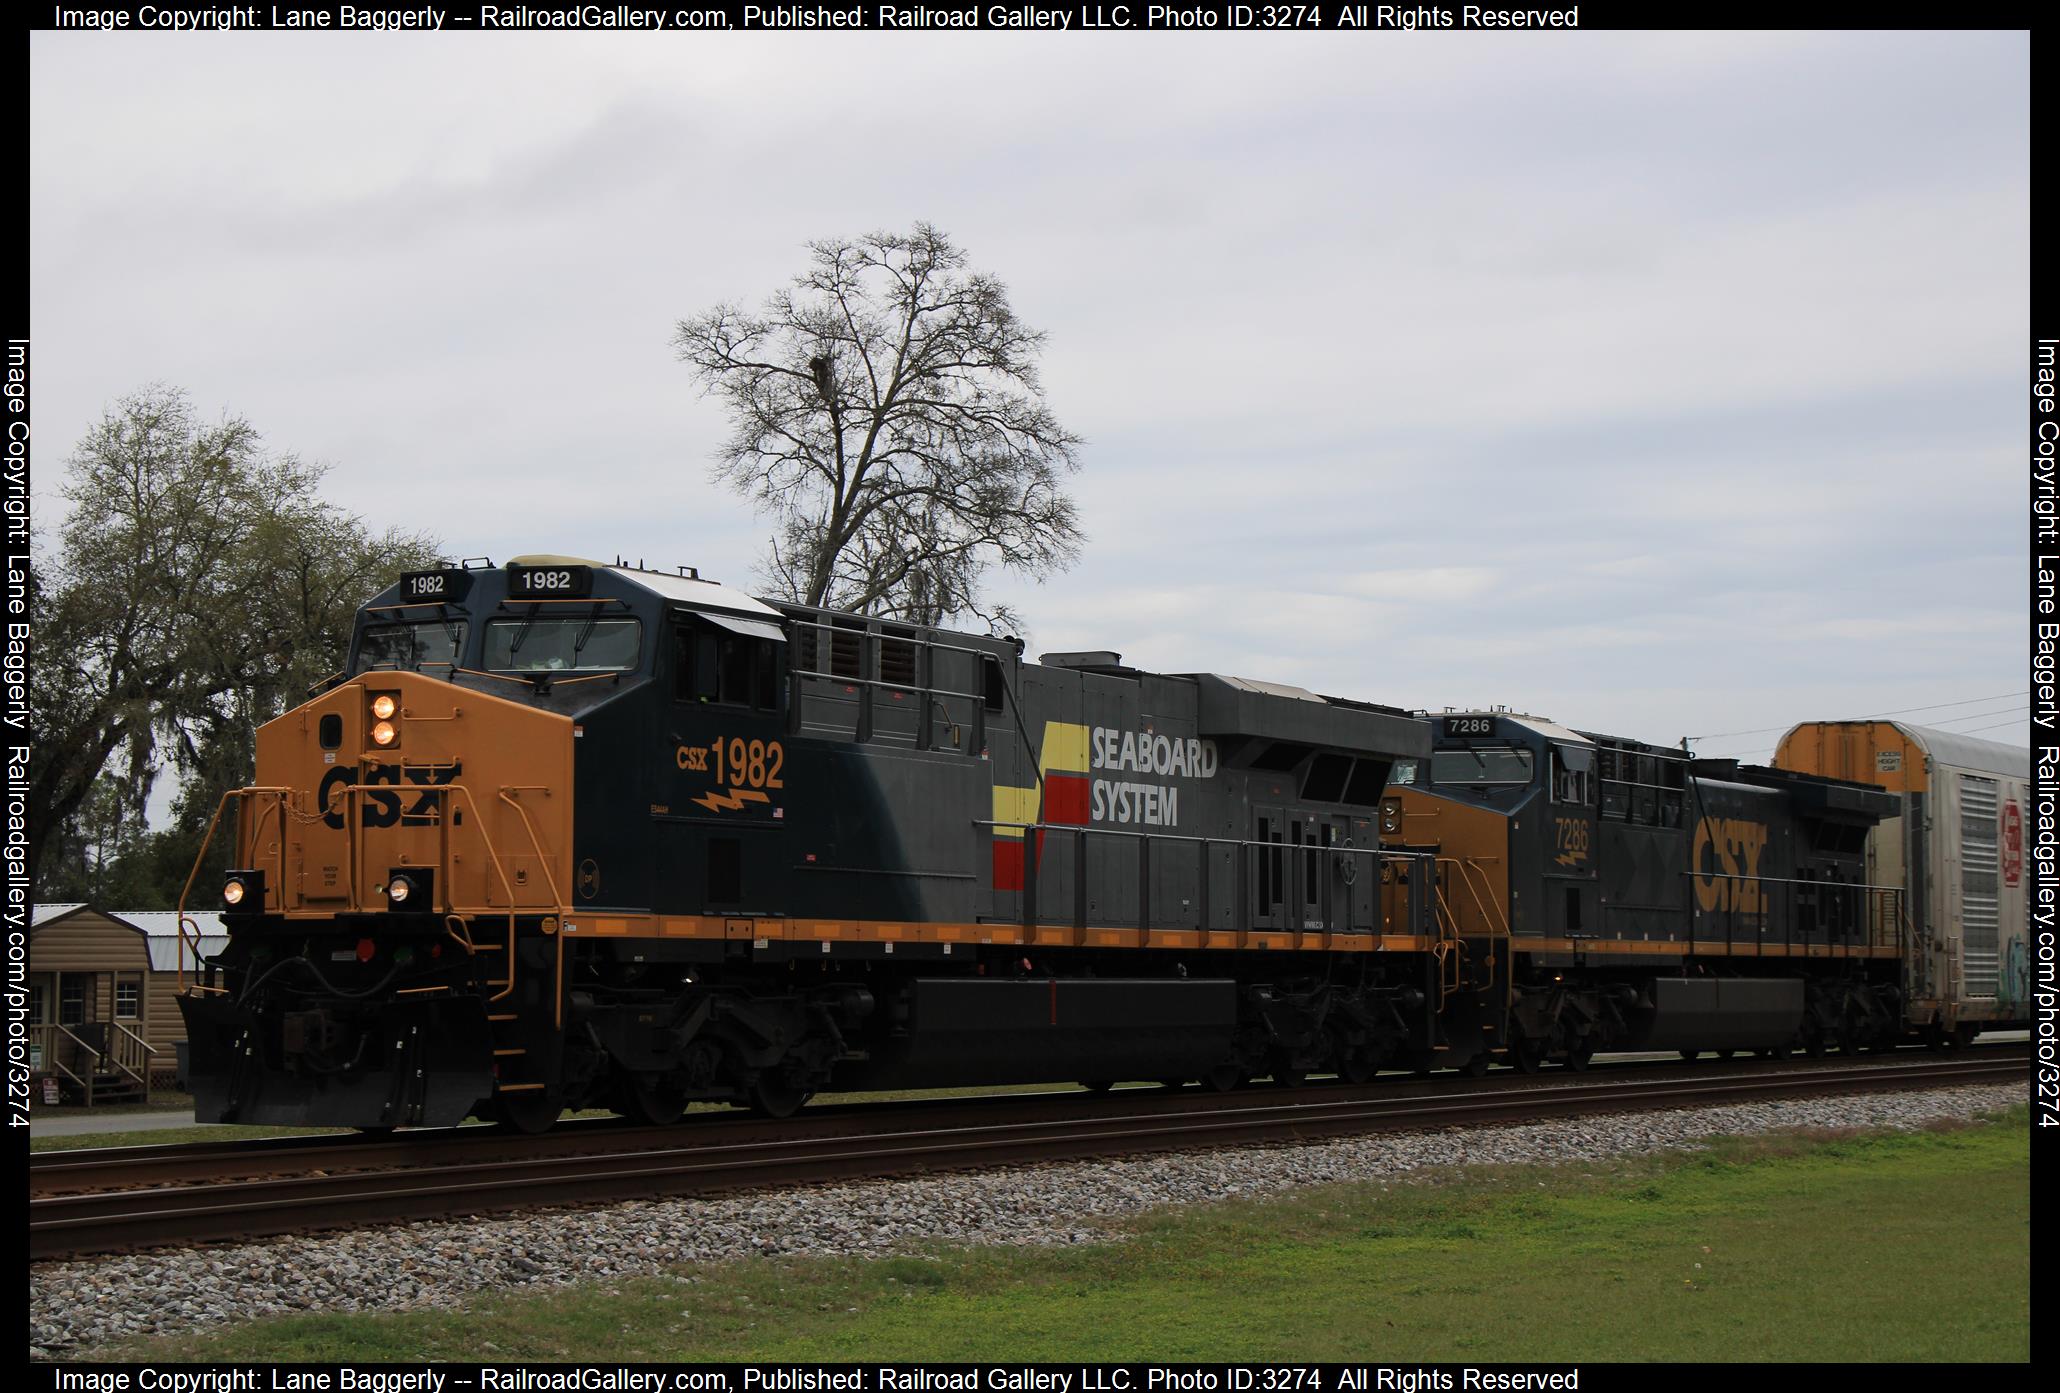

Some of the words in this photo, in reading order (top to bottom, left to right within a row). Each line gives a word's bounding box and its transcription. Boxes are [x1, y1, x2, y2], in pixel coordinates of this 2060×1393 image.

[411, 575, 444, 594] 1982
[522, 571, 571, 589] 1982
[1450, 719, 1490, 732] 7286
[676, 745, 708, 771] CSX
[711, 735, 784, 789] 1982
[1092, 726, 1218, 778] SEABOARD
[318, 764, 462, 829] CSX
[1092, 779, 1178, 826] SYSTEM
[1555, 817, 1589, 851] 7286
[1692, 815, 1768, 914] CSX
